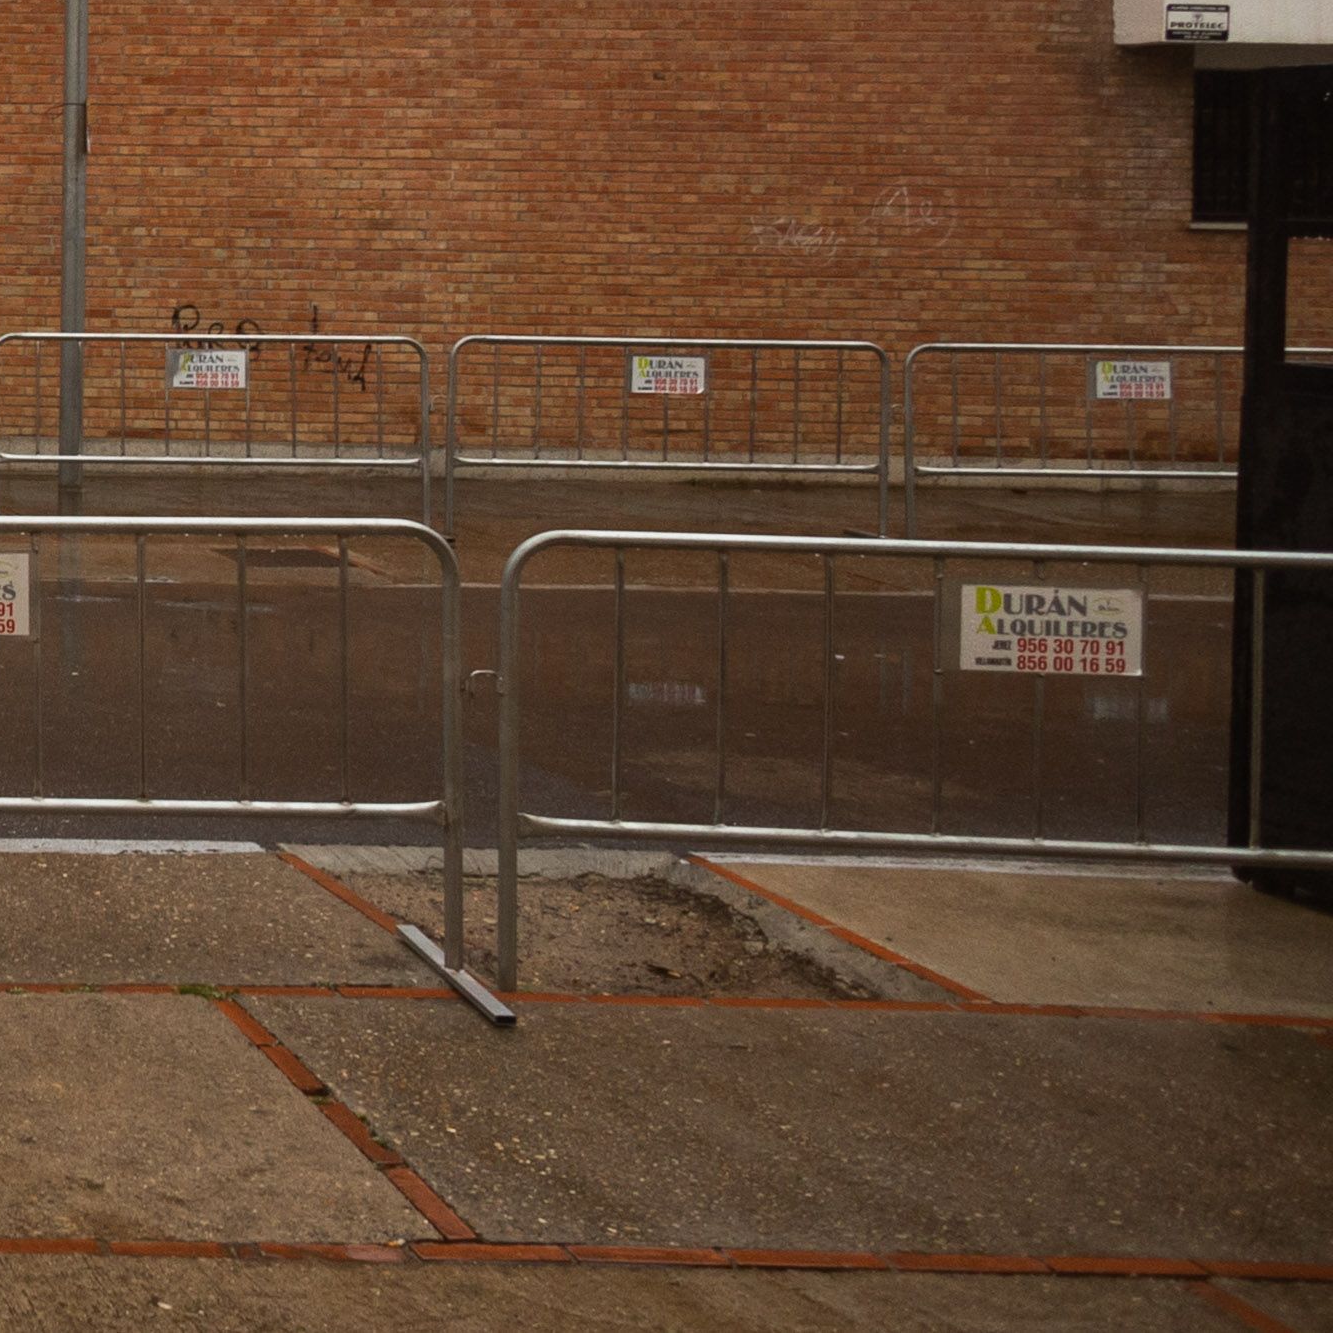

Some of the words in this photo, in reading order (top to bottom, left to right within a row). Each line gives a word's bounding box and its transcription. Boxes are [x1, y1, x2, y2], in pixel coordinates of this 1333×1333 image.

[975, 586, 1087, 616] DURÁN
[976, 616, 1127, 638] ALQUILERES
[1017, 638, 1048, 653] 956
[1053, 639, 1074, 654] 30
[1080, 640, 1099, 655] 70
[1105, 640, 1125, 656] 91
[1017, 655, 1048, 670] 856
[1053, 656, 1073, 671] 00
[1080, 657, 1099, 672] 16
[1105, 658, 1125, 673] 59
